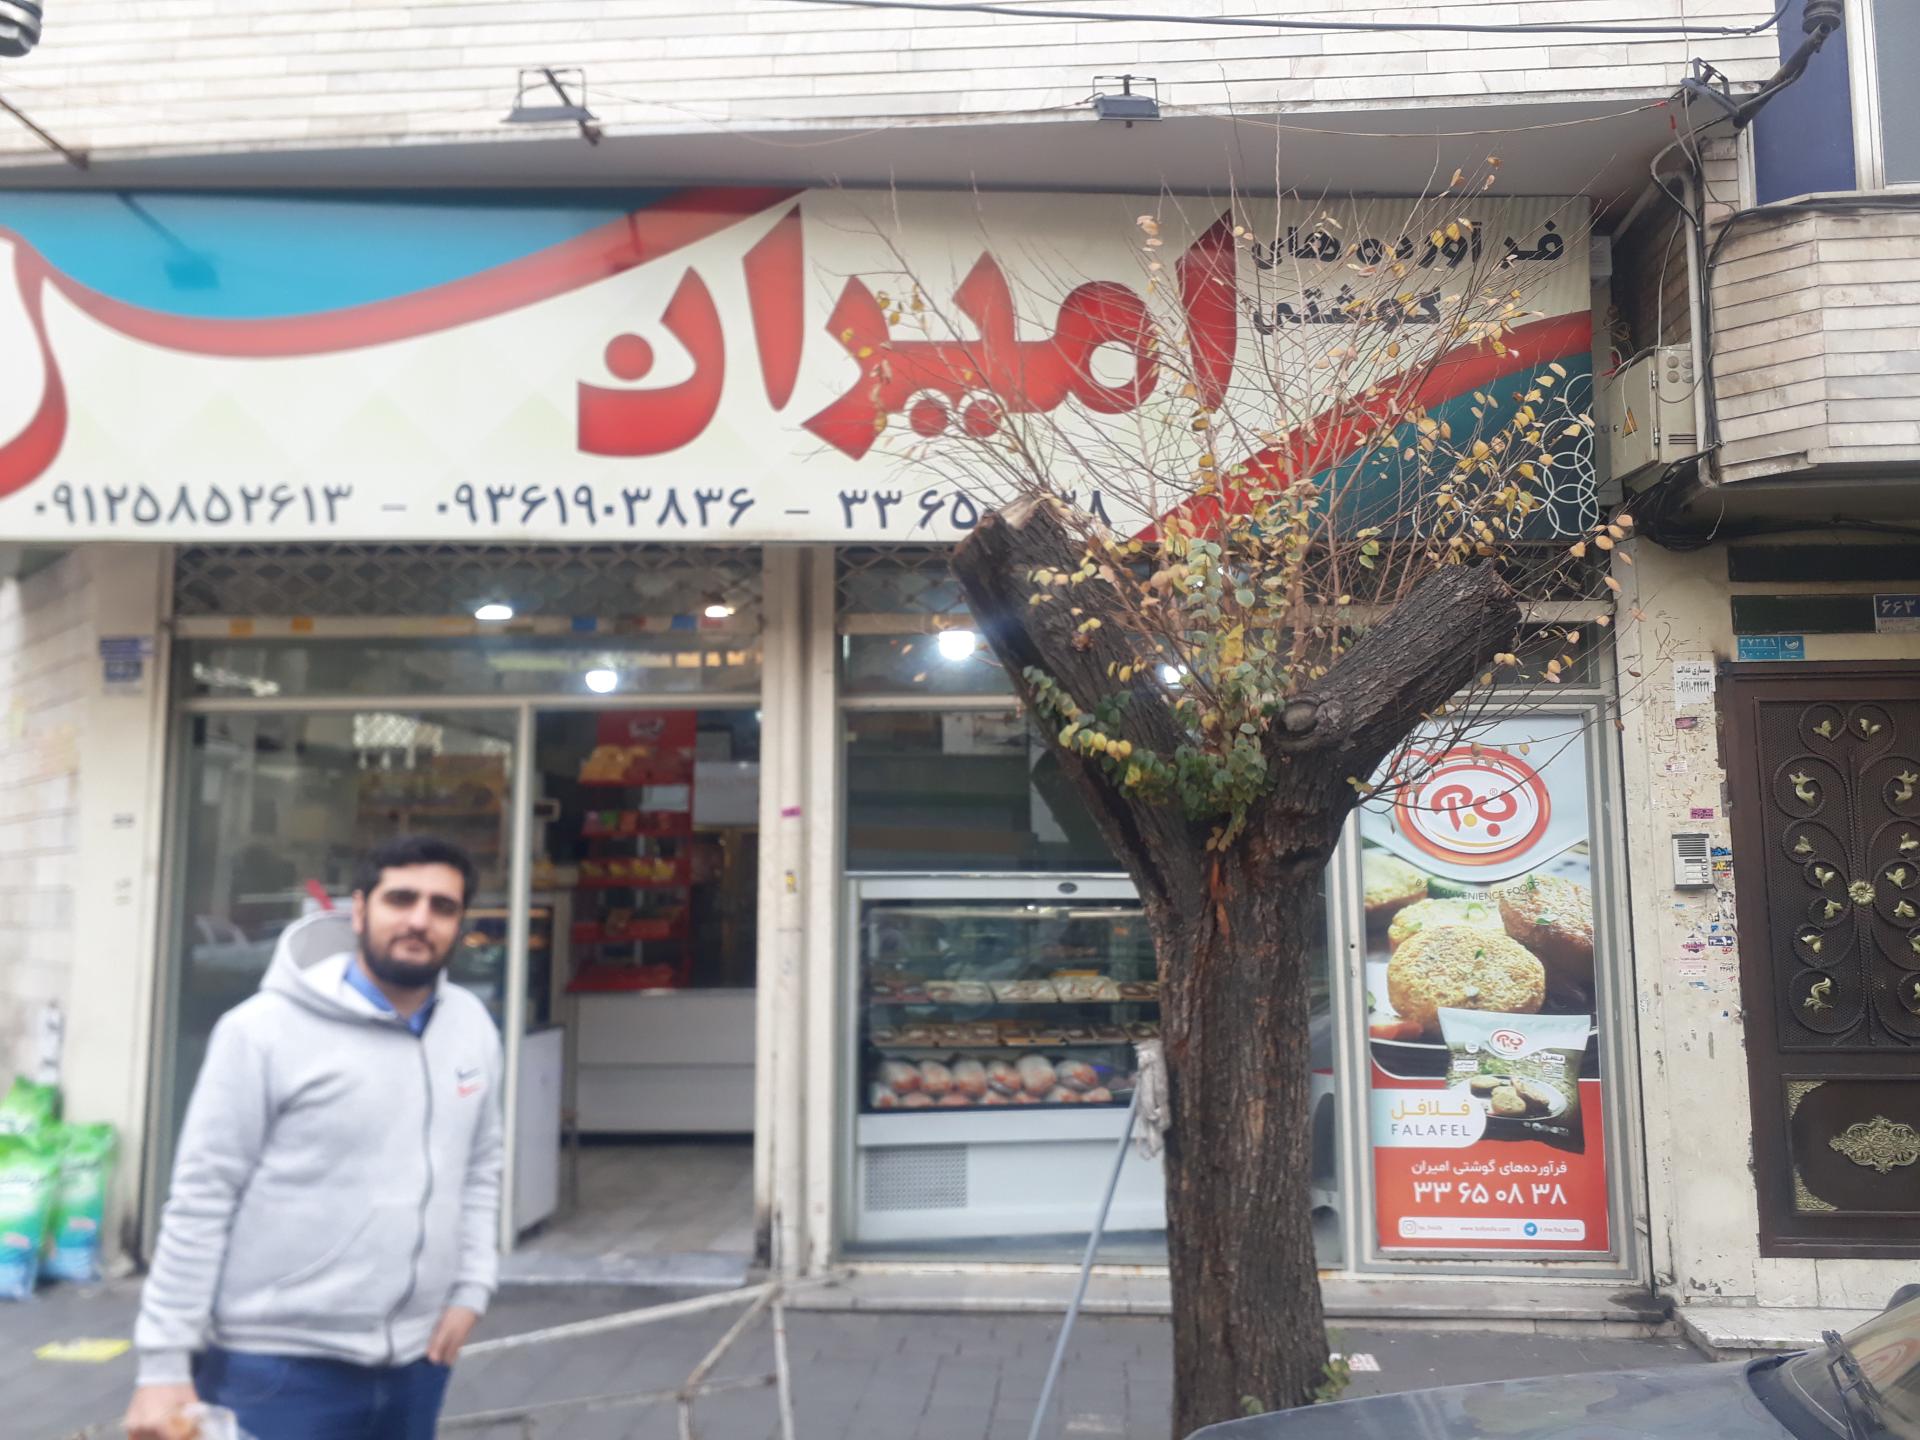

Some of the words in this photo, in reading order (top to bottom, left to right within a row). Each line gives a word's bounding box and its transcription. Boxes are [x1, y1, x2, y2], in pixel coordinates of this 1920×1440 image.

[577, 204, 1237, 461] امیران
[35, 484, 351, 524] ۰۹۱۲۵۸۵۲۶۱۳
[438, 484, 756, 526] ۰۹۳۶۱۹۰۳۸۳۶
[1391, 1099, 1471, 1120] فلافل
[1391, 1123, 1471, 1137] FALAFEL
[1411, 1159, 1450, 1175] امیران
[1453, 1159, 1496, 1176] گوشتی
